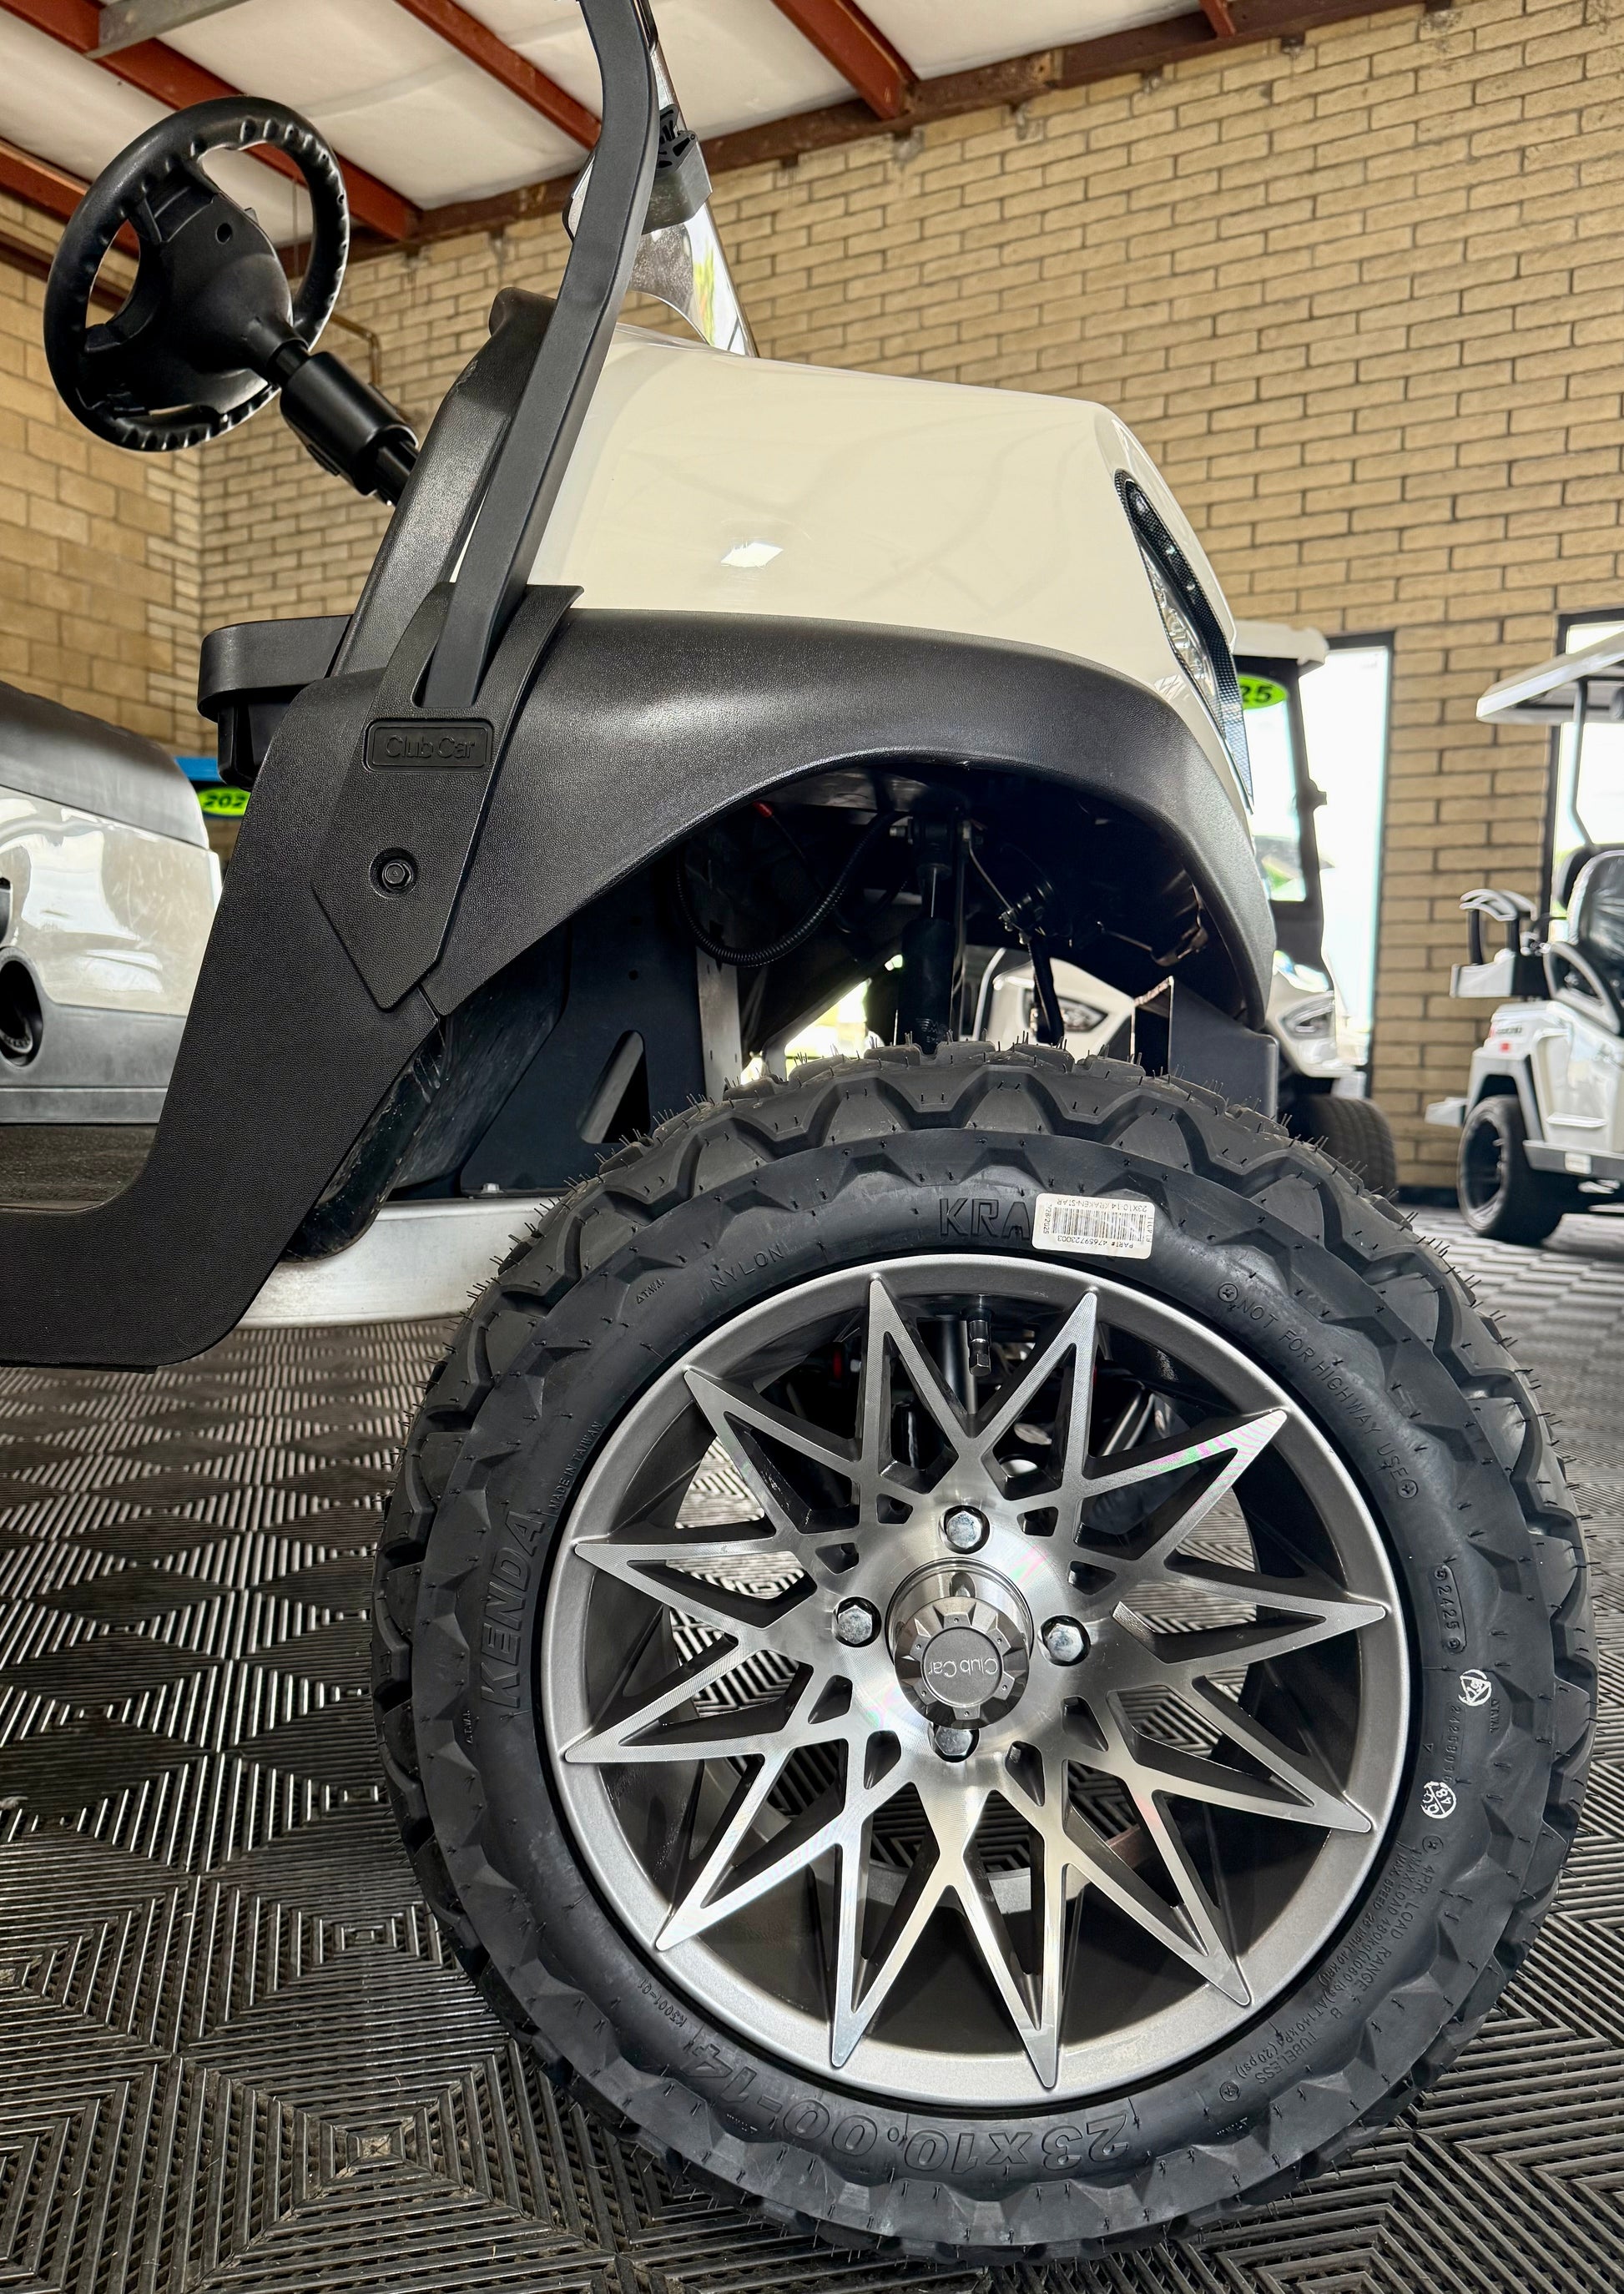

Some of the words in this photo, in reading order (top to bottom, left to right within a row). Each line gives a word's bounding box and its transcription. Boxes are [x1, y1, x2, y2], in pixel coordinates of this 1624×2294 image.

[386, 735, 434, 758] Club
[437, 736, 476, 759] Car
[1057, 1235, 1107, 1247] 47659723003
[710, 1241, 784, 1292] NYLON
[1238, 1298, 1279, 1329] NOT
[1279, 1329, 1316, 1363] FOR
[1311, 1360, 1382, 1434] HIGHWAY
[1377, 1442, 1409, 1480] USE
[548, 1477, 570, 1510] MADE
[563, 1463, 577, 1477] IN
[572, 1421, 602, 1461] TAIWAN
[481, 1510, 546, 1709] KENDA
[1436, 1585, 1460, 1630] 2425
[928, 1661, 957, 1677] Car
[960, 1657, 998, 1676] Club
[1391, 1902, 1420, 1940] LOAD
[1359, 1946, 1393, 1992] RANGE
[1254, 2031, 1319, 2085] TUBELESS
